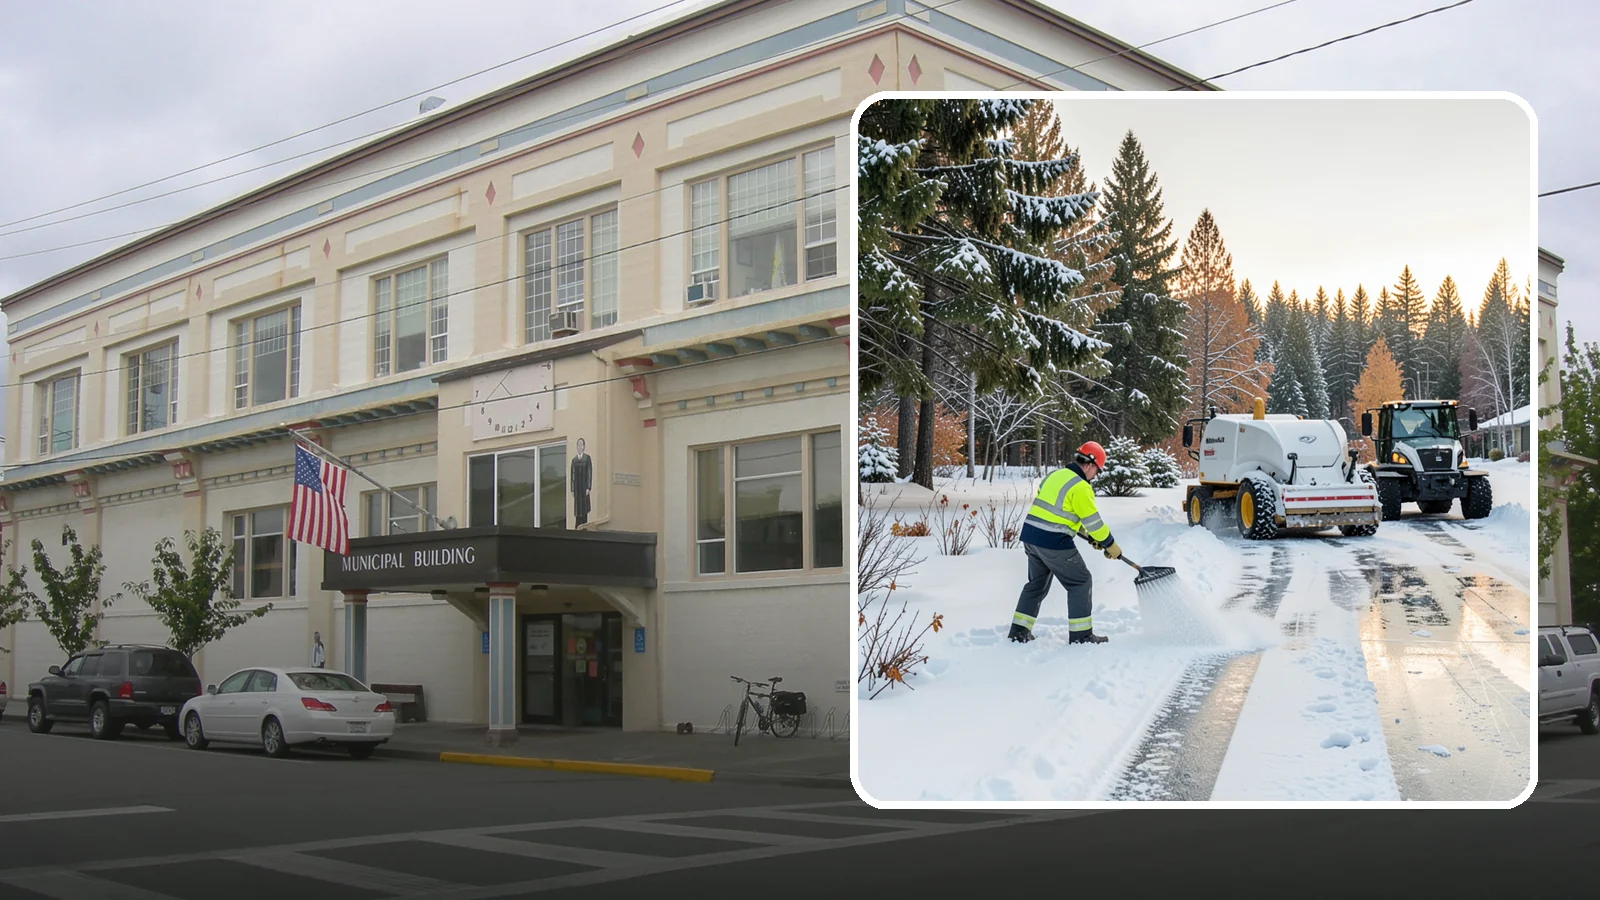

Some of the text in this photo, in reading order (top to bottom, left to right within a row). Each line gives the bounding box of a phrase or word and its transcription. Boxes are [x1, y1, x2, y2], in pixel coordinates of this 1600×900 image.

[476, 390, 479, 398] 7
[536, 402, 540, 410] 4
[481, 406, 484, 415] 8
[488, 418, 492, 426] 9
[529, 414, 532, 422] 3
[494, 424, 500, 432] 10
[521, 420, 525, 428] 2
[342, 546, 475, 572] MUNICIPAL BUILDING
